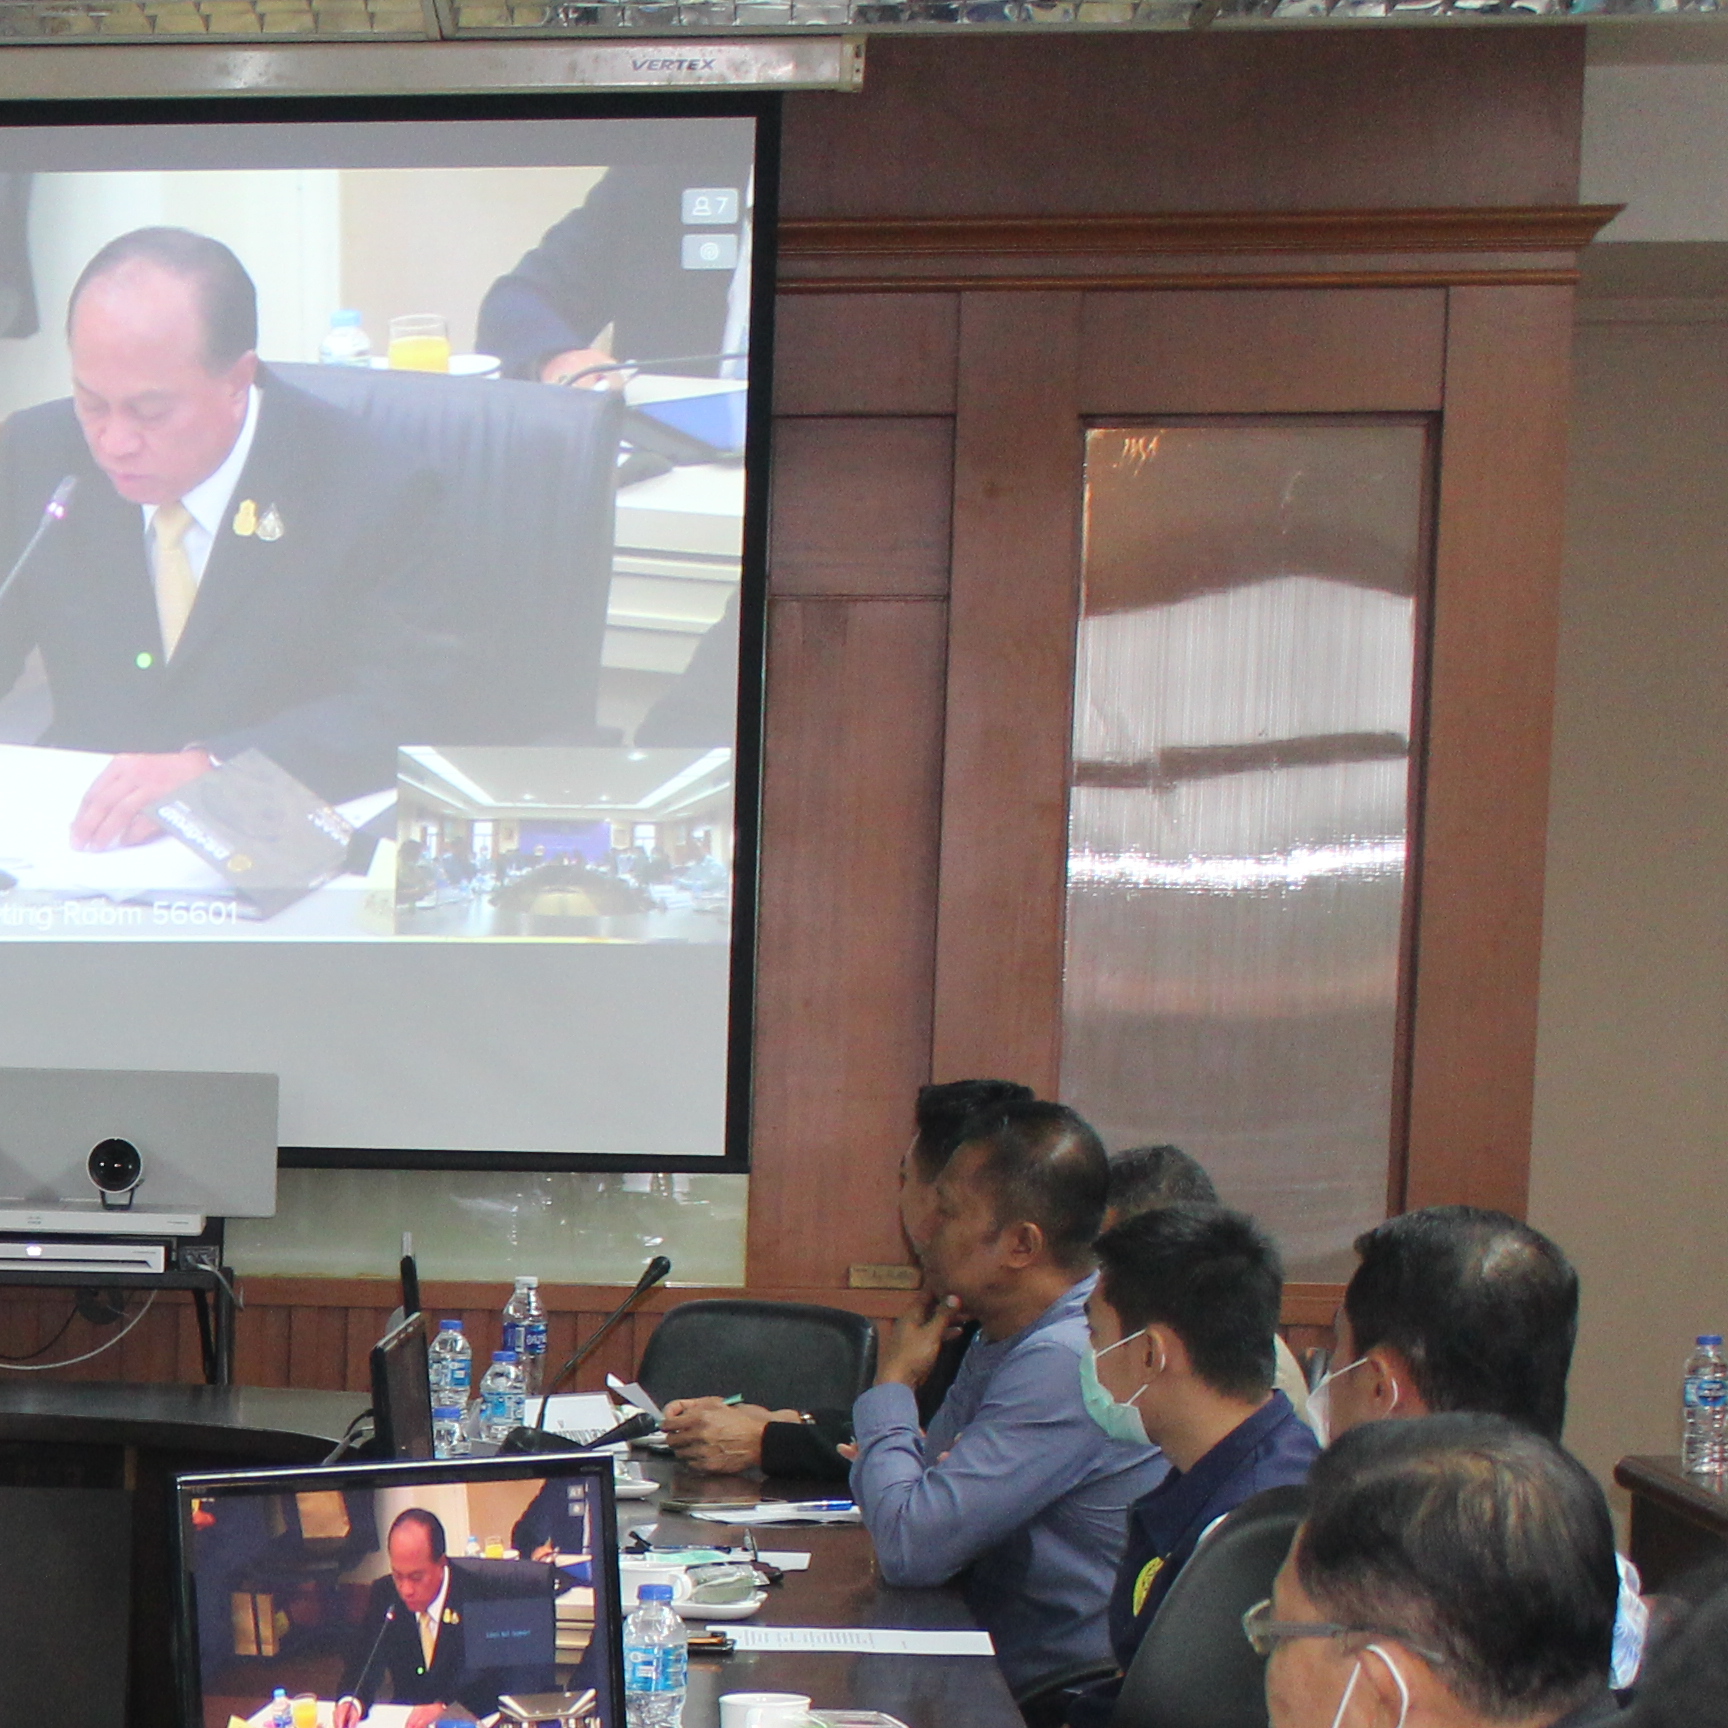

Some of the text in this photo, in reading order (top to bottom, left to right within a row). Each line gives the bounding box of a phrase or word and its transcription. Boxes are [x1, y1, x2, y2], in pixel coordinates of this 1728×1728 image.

[632, 58, 716, 72] VERTEX
[715, 196, 728, 214] 7
[63, 899, 142, 926] Room
[153, 901, 237, 926] 56601
